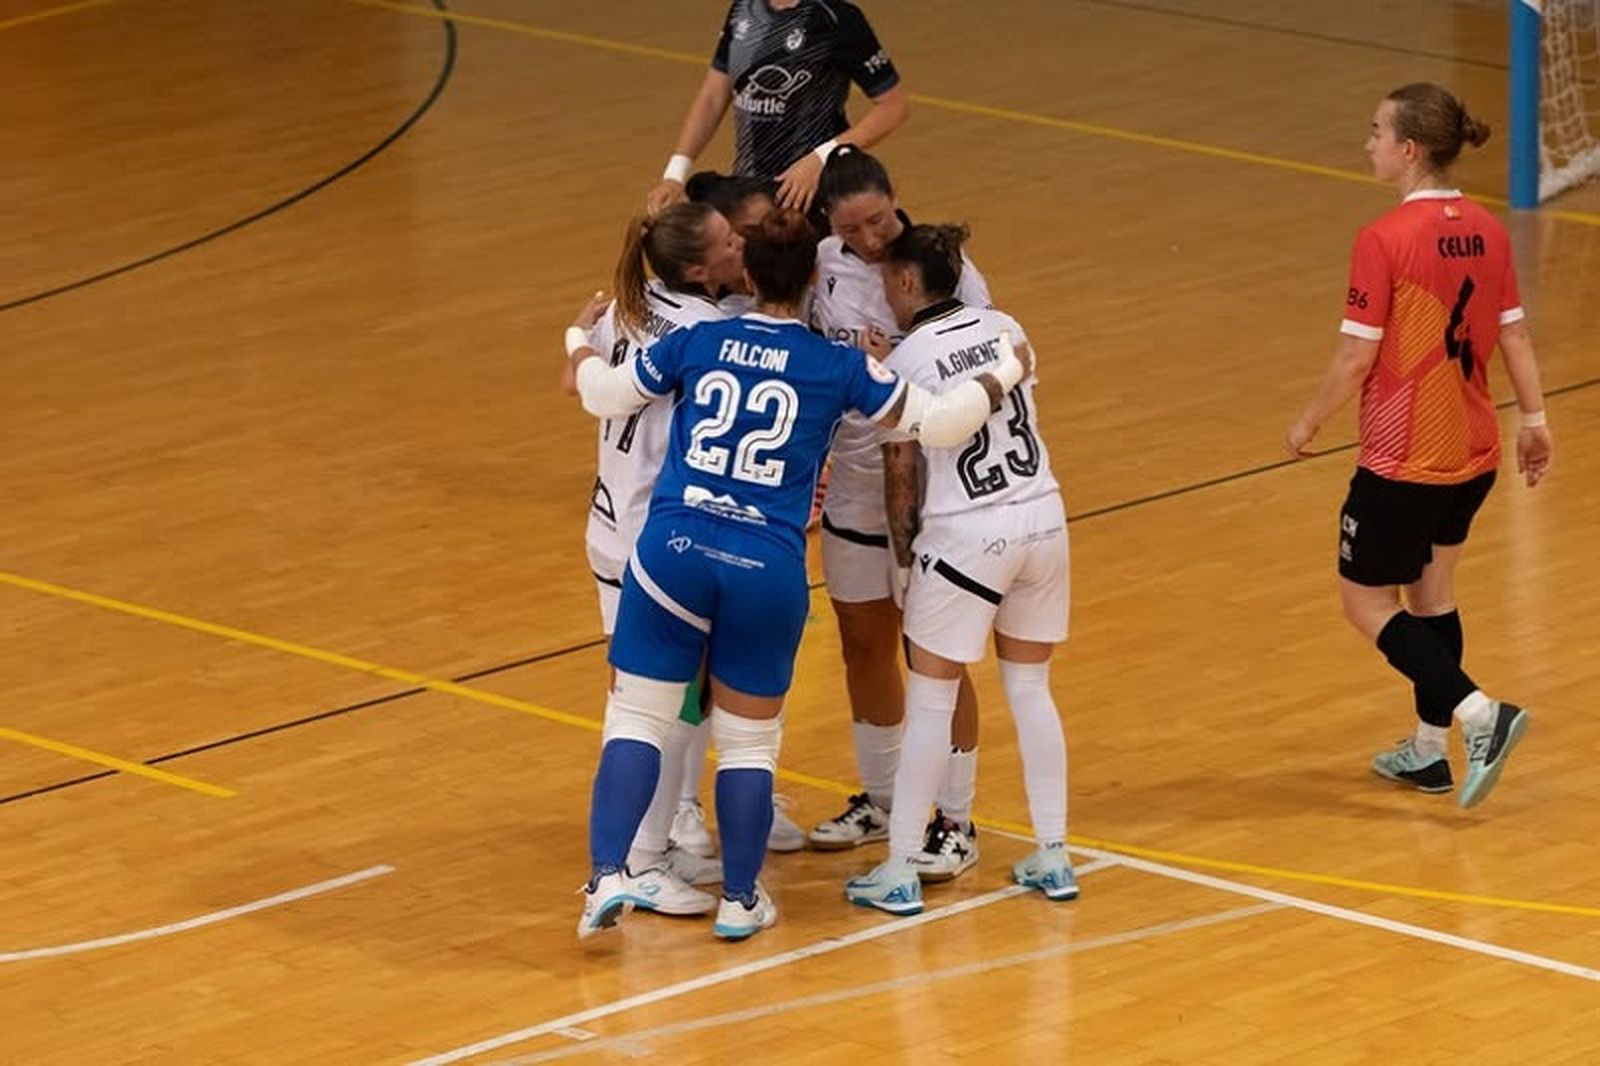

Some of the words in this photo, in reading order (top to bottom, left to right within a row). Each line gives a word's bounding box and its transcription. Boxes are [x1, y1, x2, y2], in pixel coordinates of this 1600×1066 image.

[1437, 234, 1485, 259] CELIA
[718, 338, 790, 374] FALCONI
[935, 338, 1000, 381] A.GIMENE
[1444, 275, 1475, 382] 4
[684, 369, 799, 487] 22
[956, 384, 1040, 500] 23
